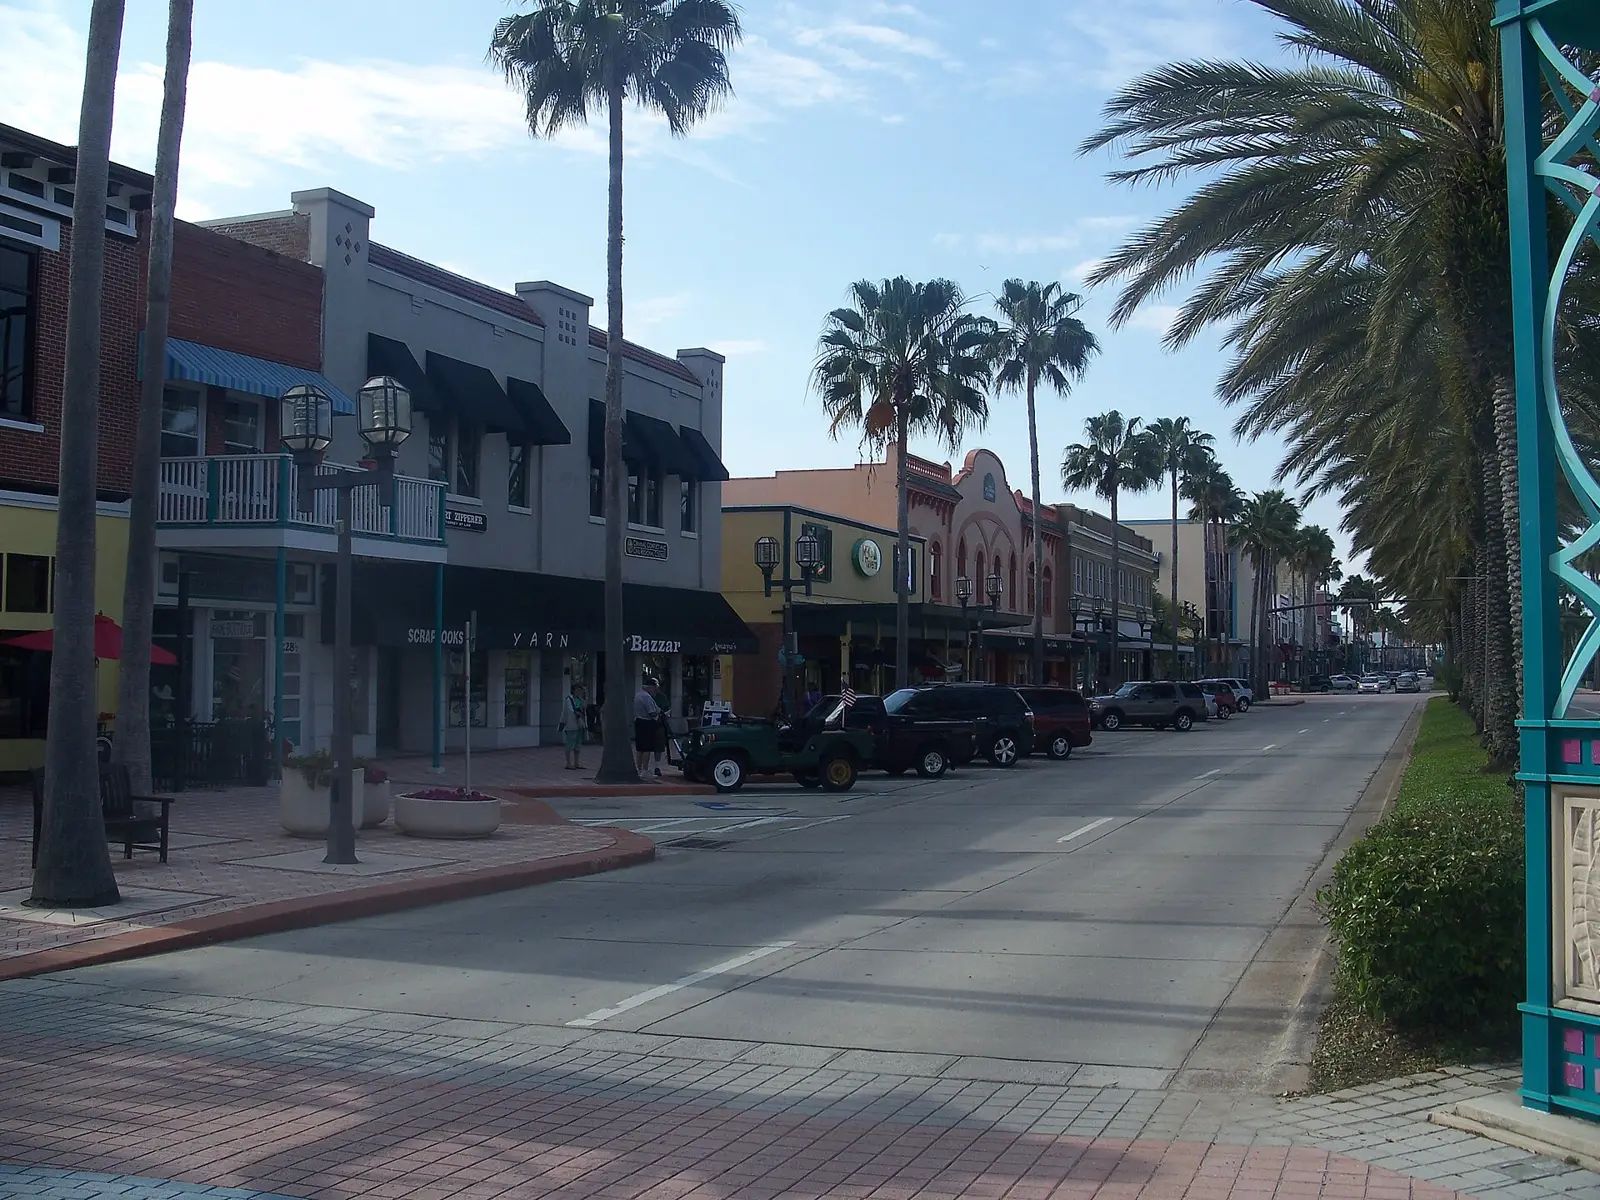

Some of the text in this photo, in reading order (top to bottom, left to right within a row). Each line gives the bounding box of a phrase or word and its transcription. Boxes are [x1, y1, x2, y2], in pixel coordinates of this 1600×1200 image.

[454, 512, 483, 525] ZIPPERER
[408, 628, 464, 645] SCRAPOOKS
[512, 632, 570, 648] YARN
[630, 634, 681, 653] Bazzar
